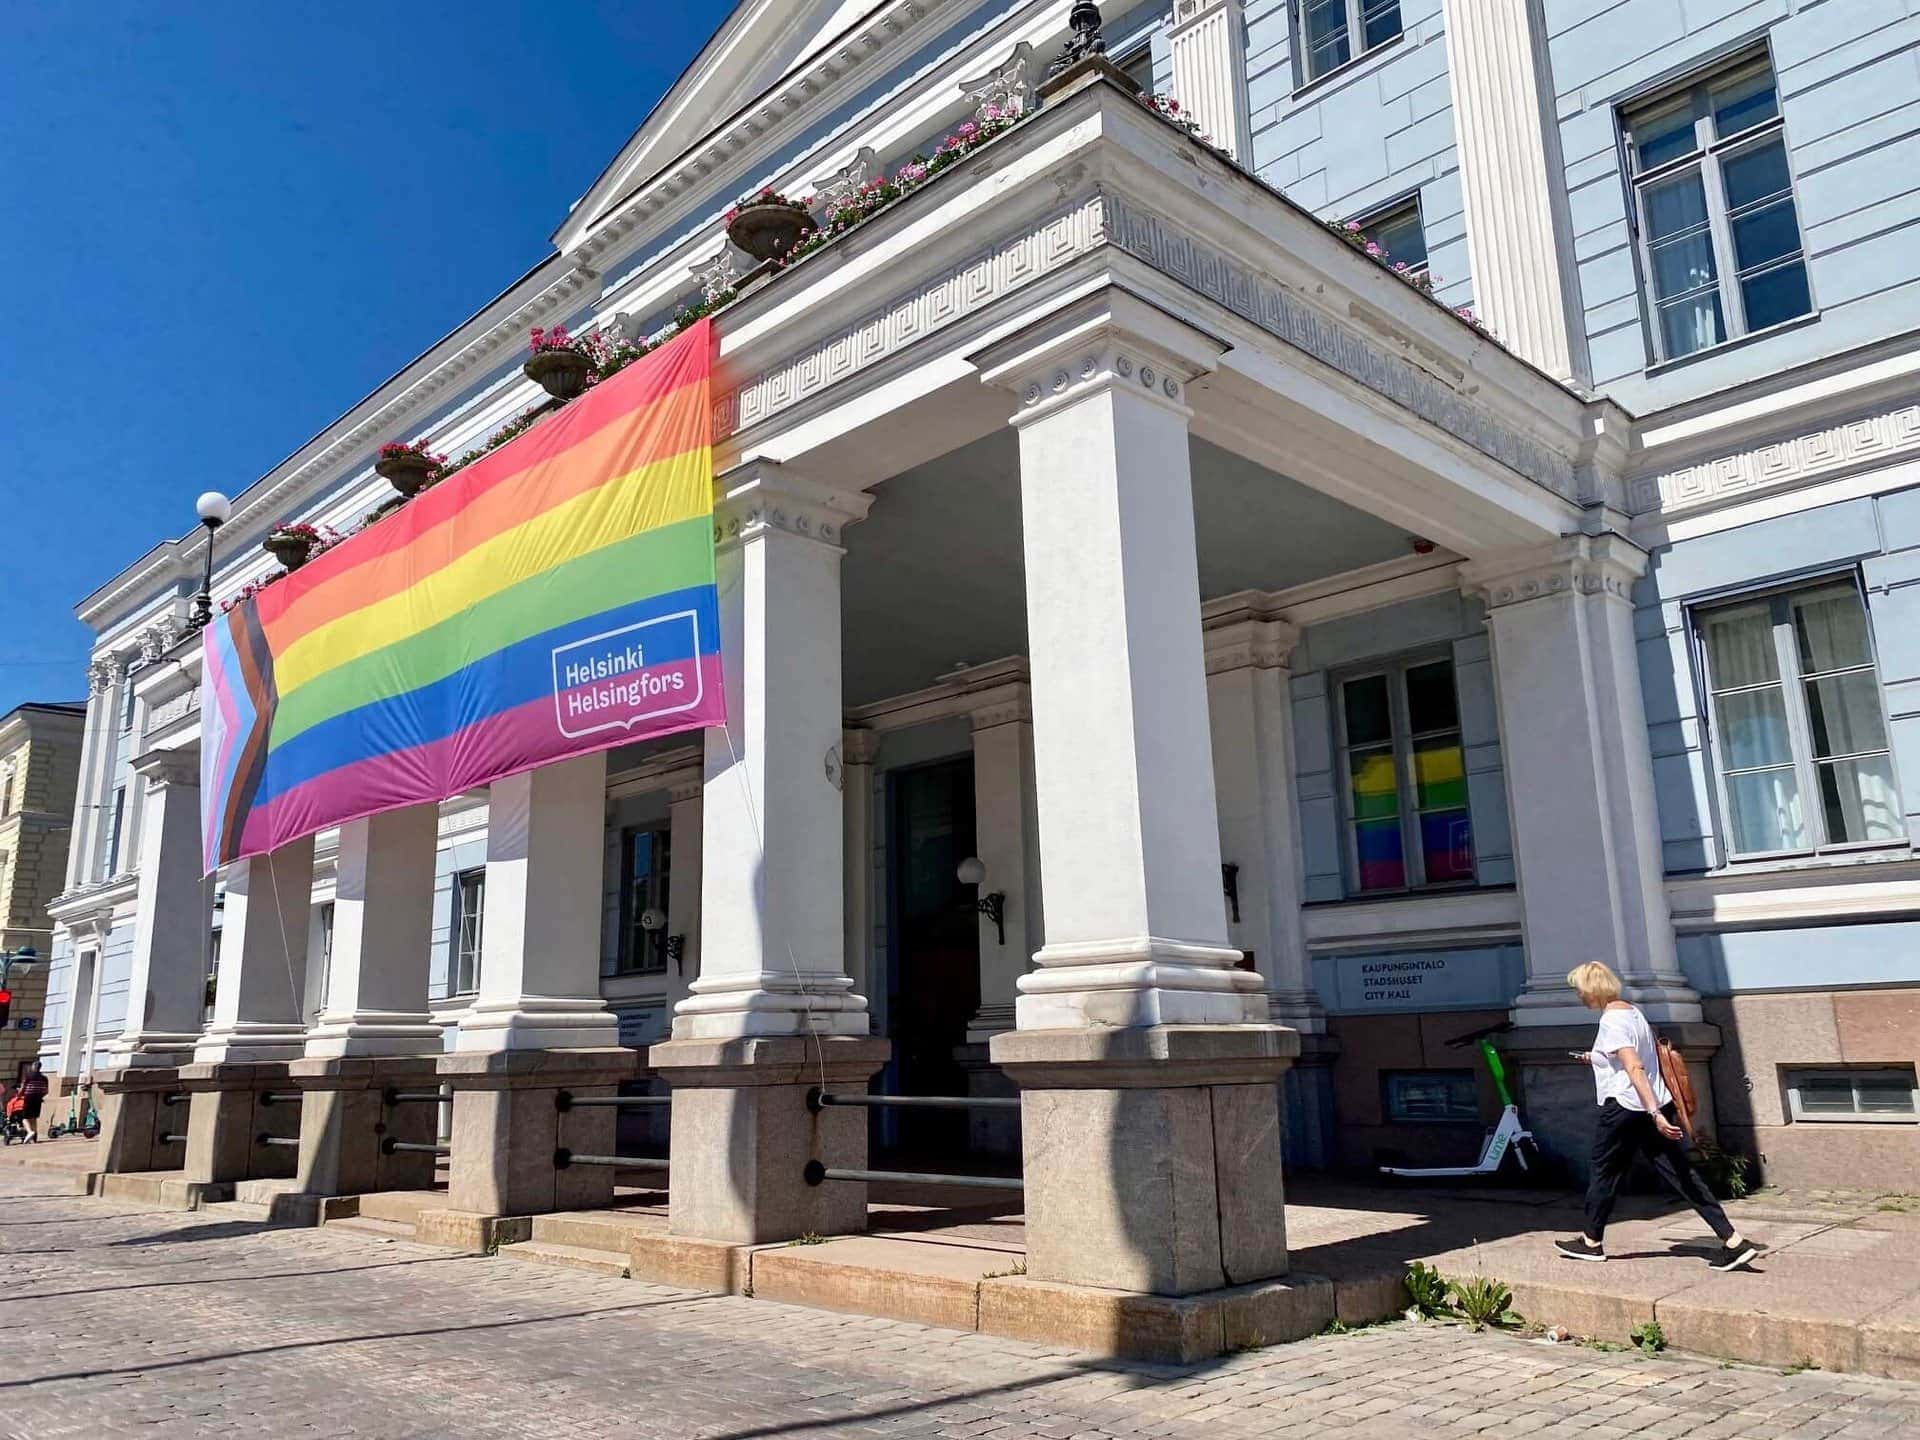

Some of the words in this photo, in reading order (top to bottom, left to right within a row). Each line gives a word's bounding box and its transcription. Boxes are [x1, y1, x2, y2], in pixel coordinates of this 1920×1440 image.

[566, 644, 644, 687] Helsinki
[569, 672, 684, 717] Helsingfors
[1362, 960, 1445, 973] KAUPUNGINTALO
[1364, 975, 1423, 987] STADSHUSET
[1365, 991, 1385, 1001] CITY
[1388, 990, 1411, 1000] HALL
[1488, 1135, 1506, 1159] Lime
